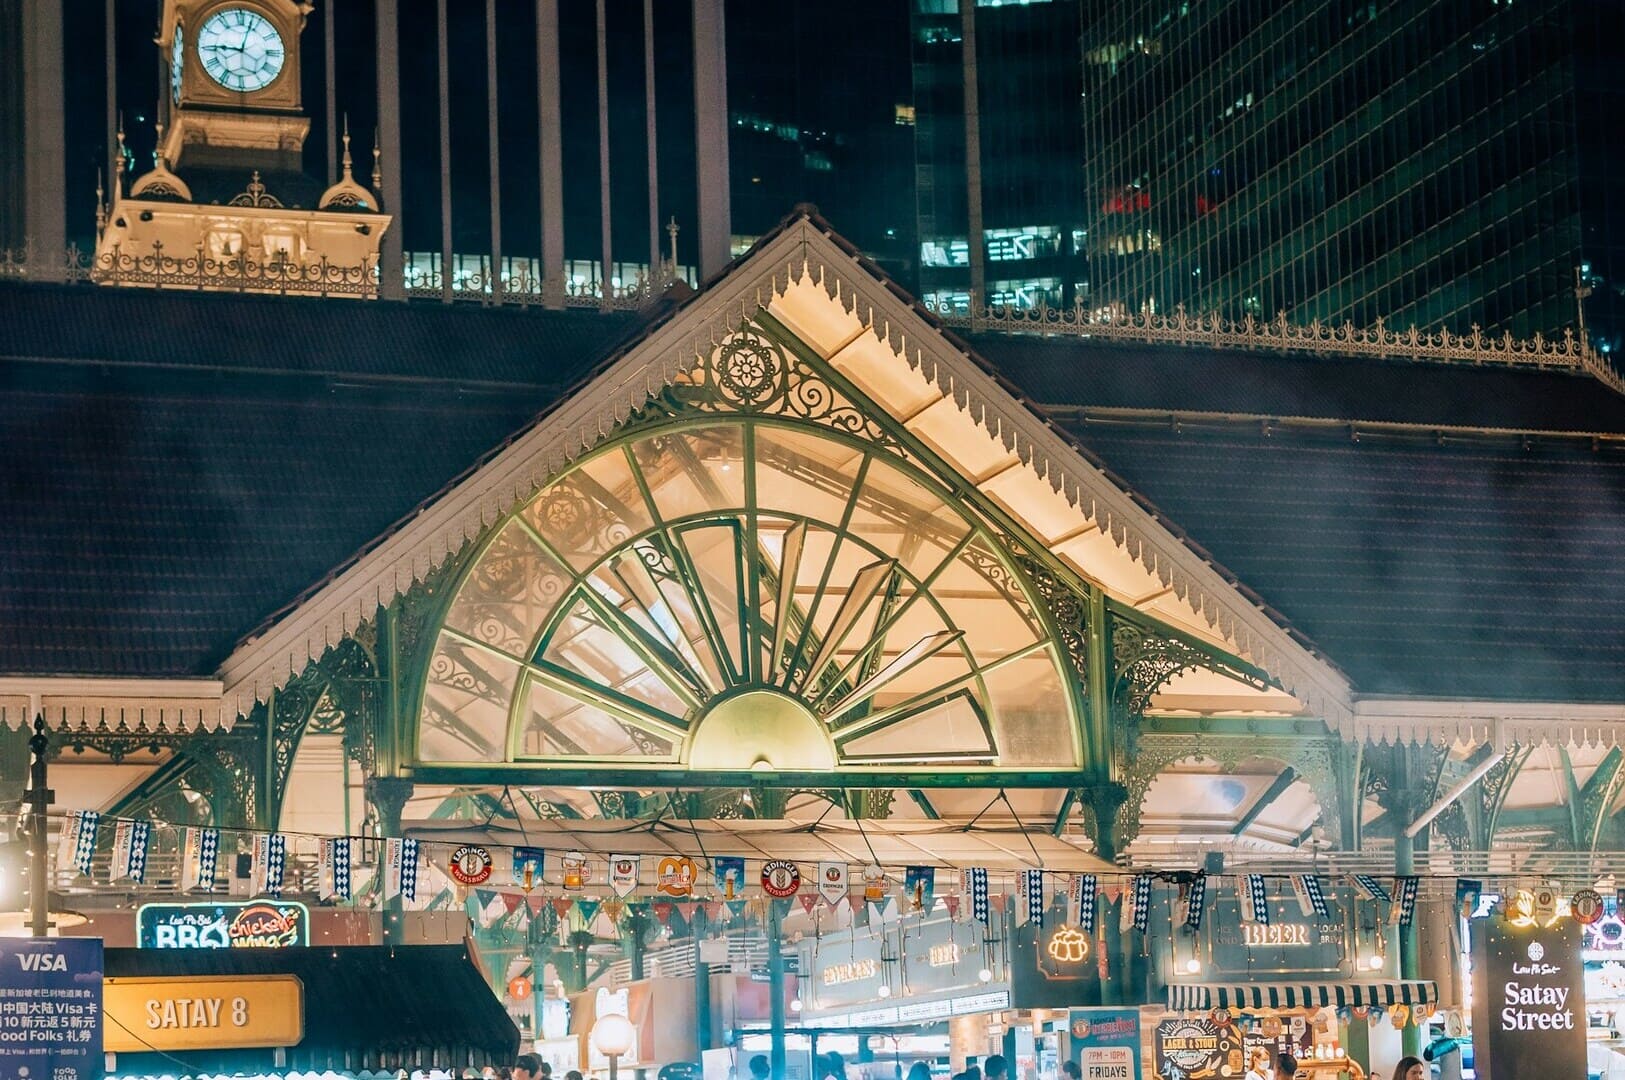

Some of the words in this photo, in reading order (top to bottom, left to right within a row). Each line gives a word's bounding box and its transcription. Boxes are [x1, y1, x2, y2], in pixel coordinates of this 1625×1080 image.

[453, 847, 490, 865] ERDINGER
[763, 861, 799, 877] ERDINGER
[1243, 924, 1311, 945] BEER
[15, 953, 68, 971] VISA
[1504, 982, 1569, 1011] Satay
[56, 1003, 83, 1014] Visa
[146, 999, 222, 1029] SATAY
[232, 997, 247, 1027] 8
[1501, 1007, 1574, 1031] Street
[30, 1030, 63, 1041] Folks
[1163, 1038, 1187, 1049] LAGER
[1195, 1038, 1217, 1049] STOUT
[1089, 1065, 1127, 1078] FRIDAYS
